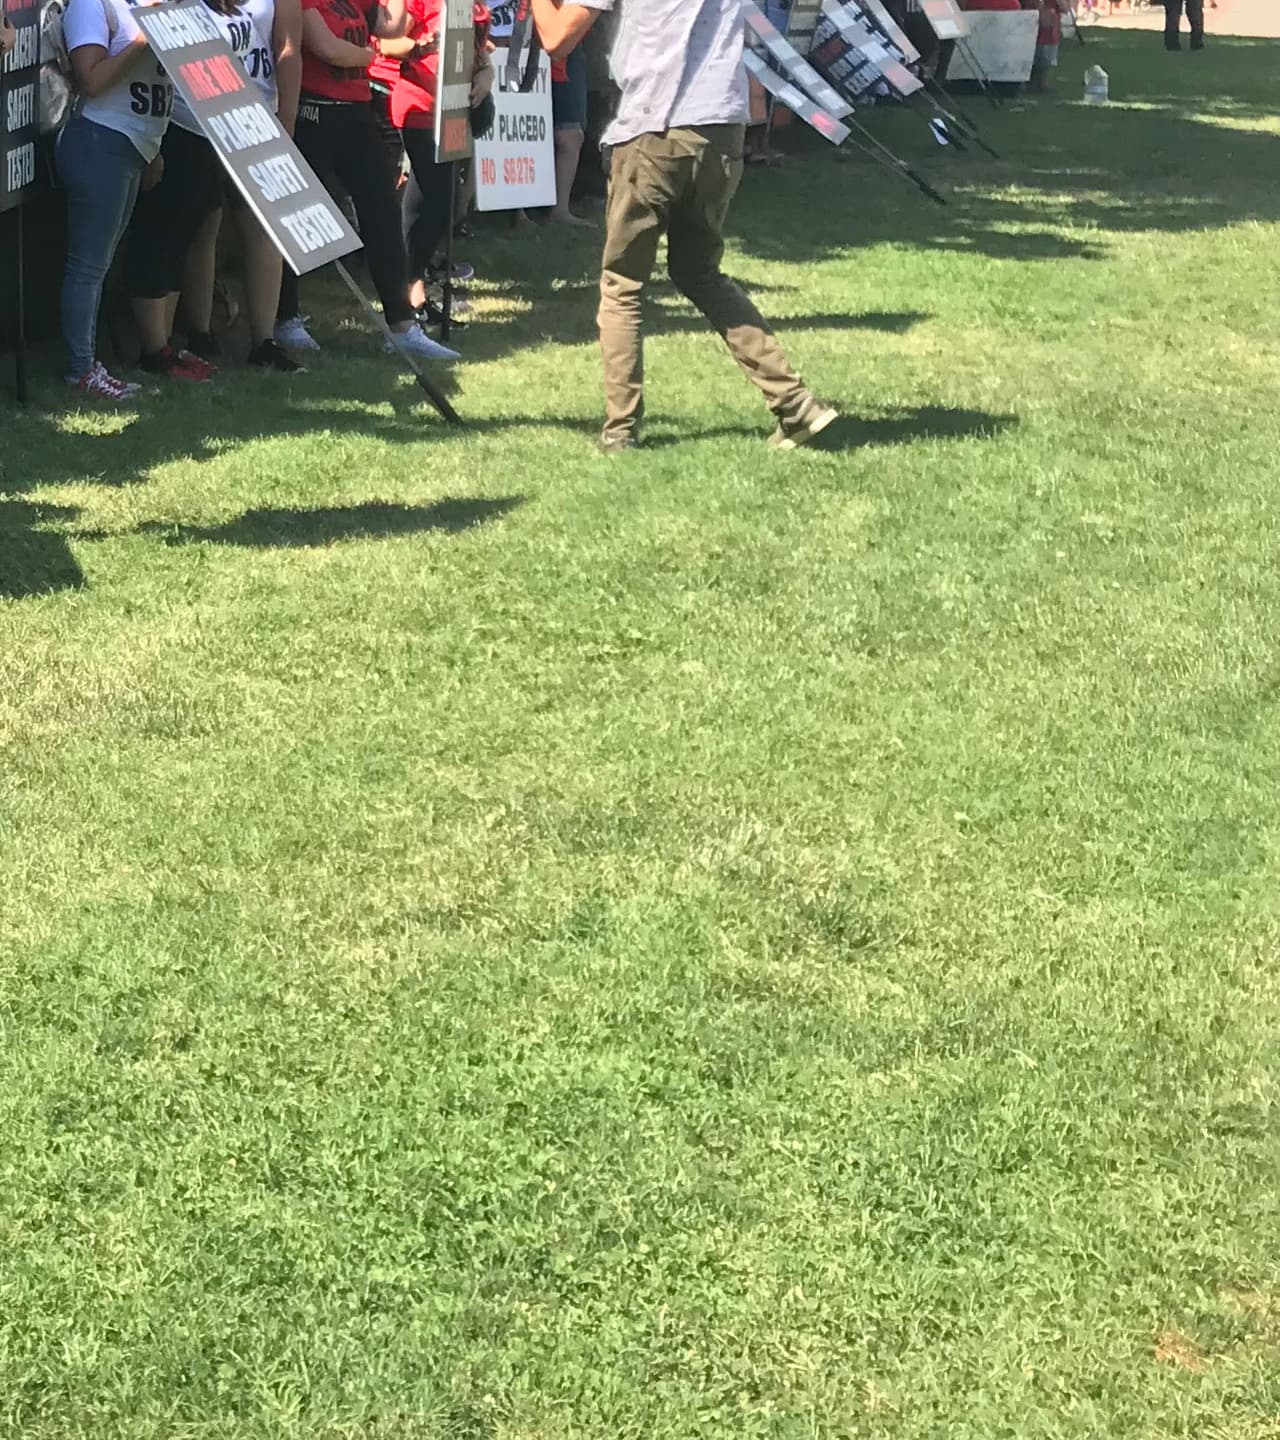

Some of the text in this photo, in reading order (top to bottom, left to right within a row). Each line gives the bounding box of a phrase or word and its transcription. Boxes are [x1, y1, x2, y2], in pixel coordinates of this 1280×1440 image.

[140, 5, 220, 52] VACCINES
[7, 83, 34, 133] SAFETY
[208, 102, 281, 153] PLACEBO
[499, 114, 546, 142] PLACEBO
[7, 142, 35, 193] TESTED
[248, 152, 309, 203] SAFETY
[481, 157, 536, 185] NO SB276
[280, 202, 345, 255] TESTED
